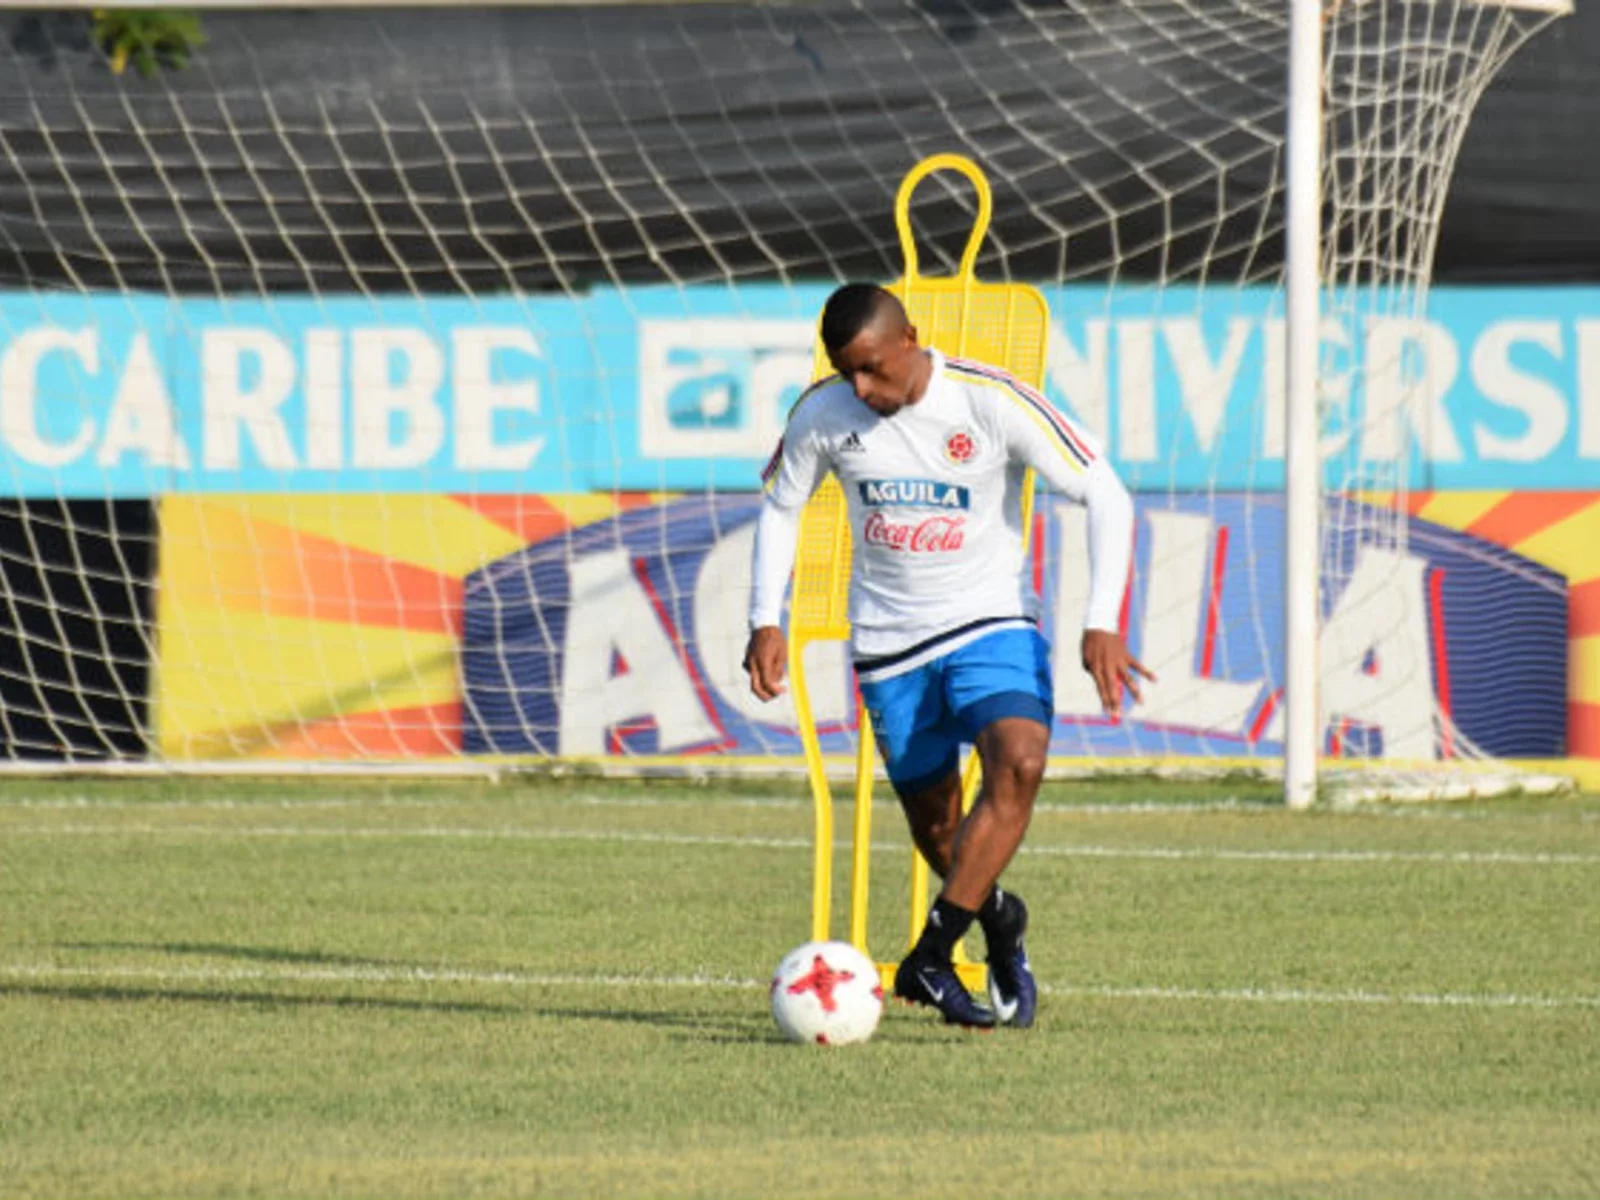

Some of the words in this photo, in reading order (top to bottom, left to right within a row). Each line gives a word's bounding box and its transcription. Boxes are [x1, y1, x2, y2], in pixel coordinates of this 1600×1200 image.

[0, 326, 542, 470] CARIBE
[1042, 318, 1600, 461] NIVERSI
[867, 481, 960, 506] AGUILA
